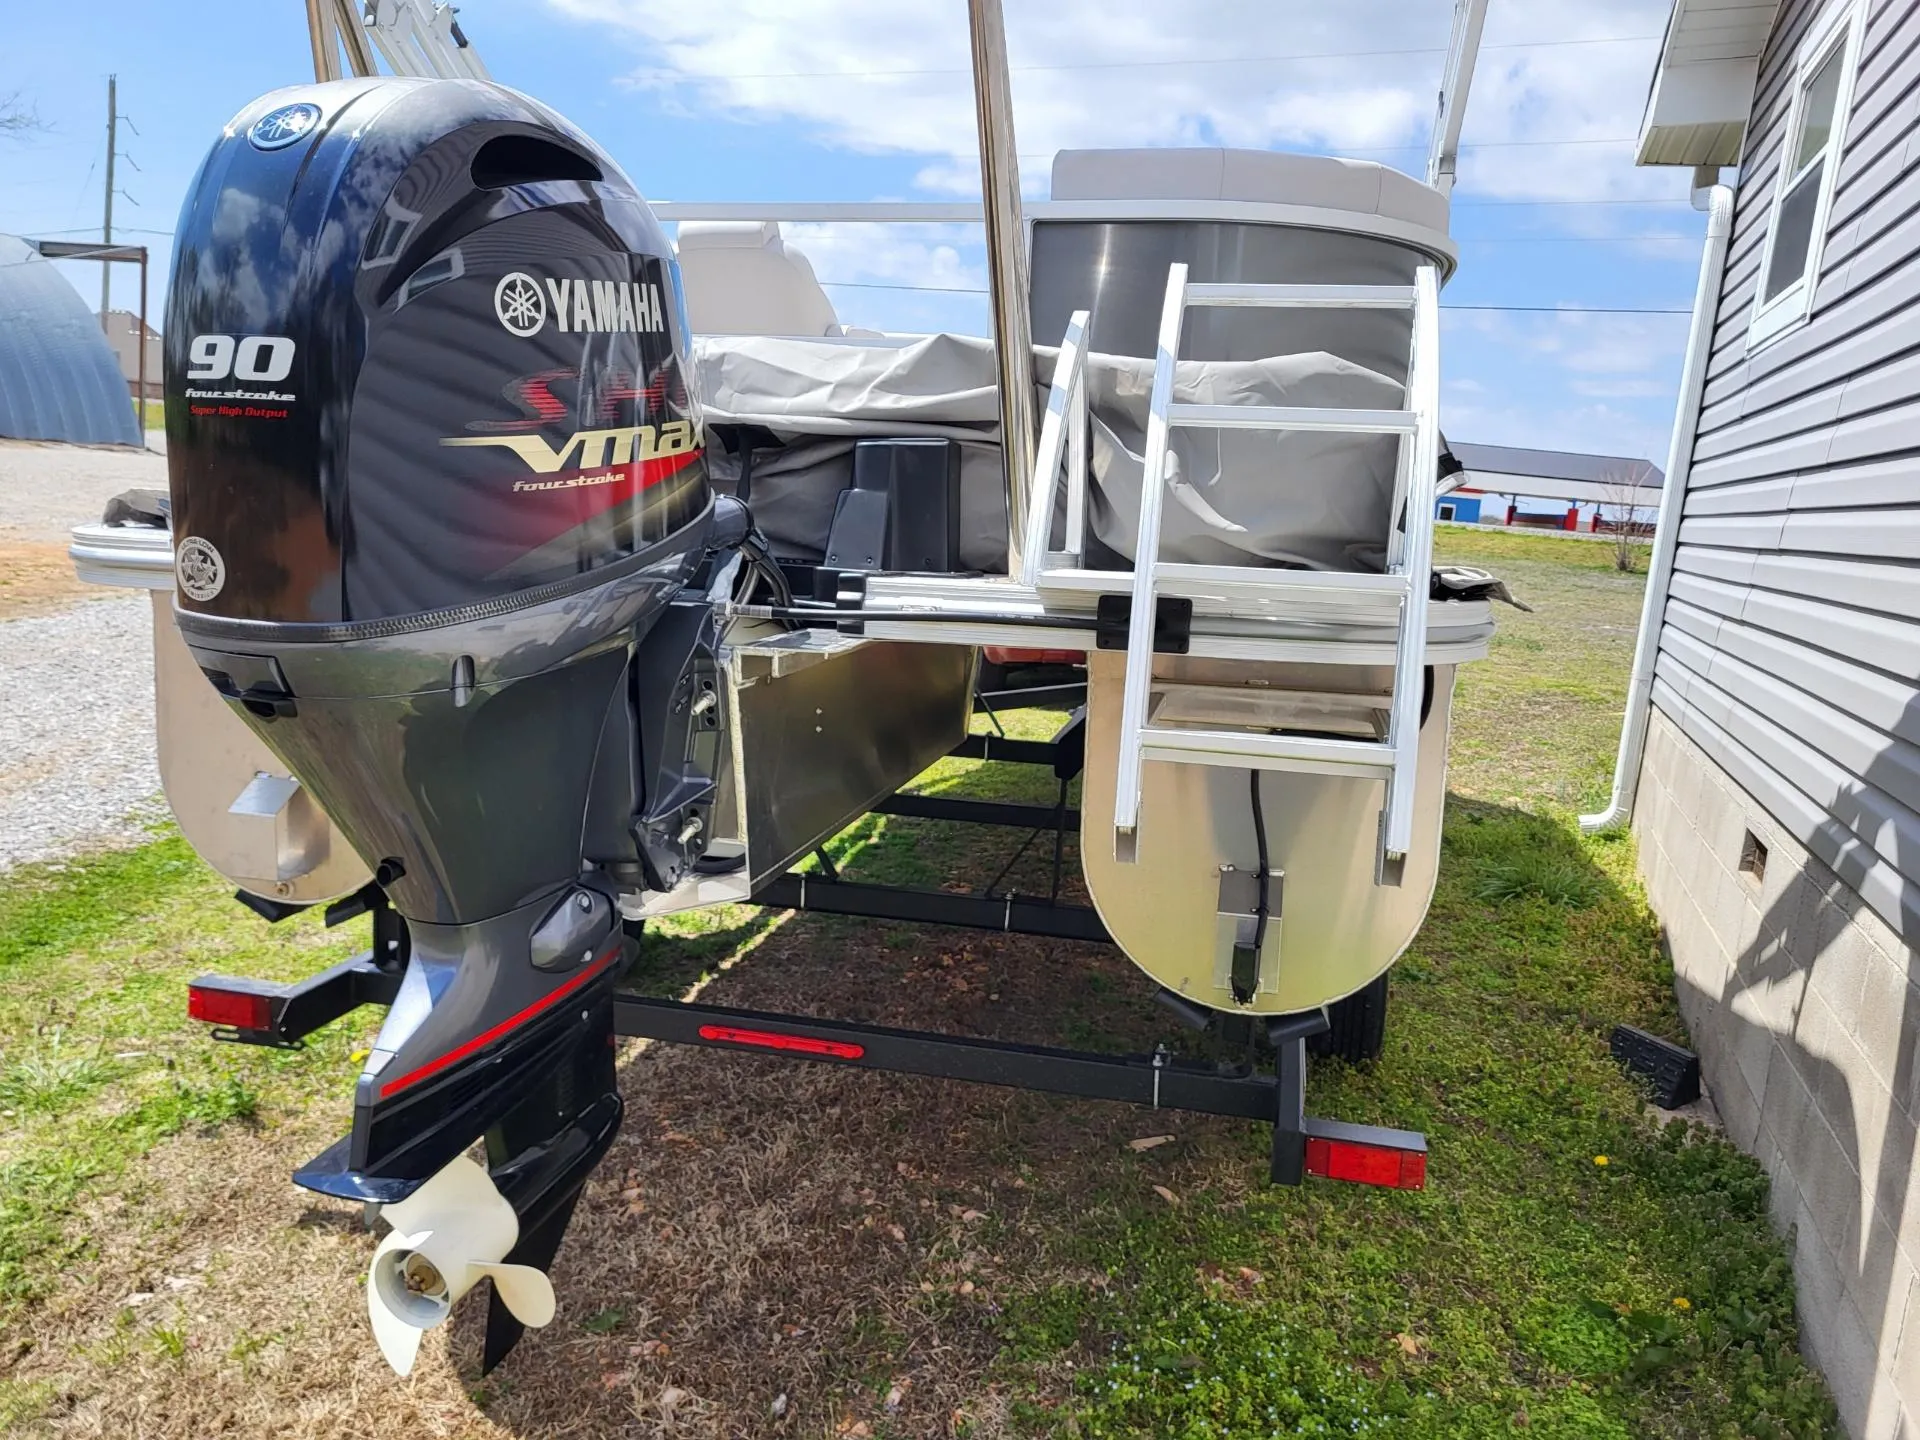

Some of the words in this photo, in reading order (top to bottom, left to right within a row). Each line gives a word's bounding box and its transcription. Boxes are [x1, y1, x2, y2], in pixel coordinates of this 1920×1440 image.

[546, 278, 664, 332] YAMAHA
[187, 335, 296, 381] 90
[190, 404, 217, 417] Super
[218, 406, 243, 417] High
[244, 407, 289, 419] Output
